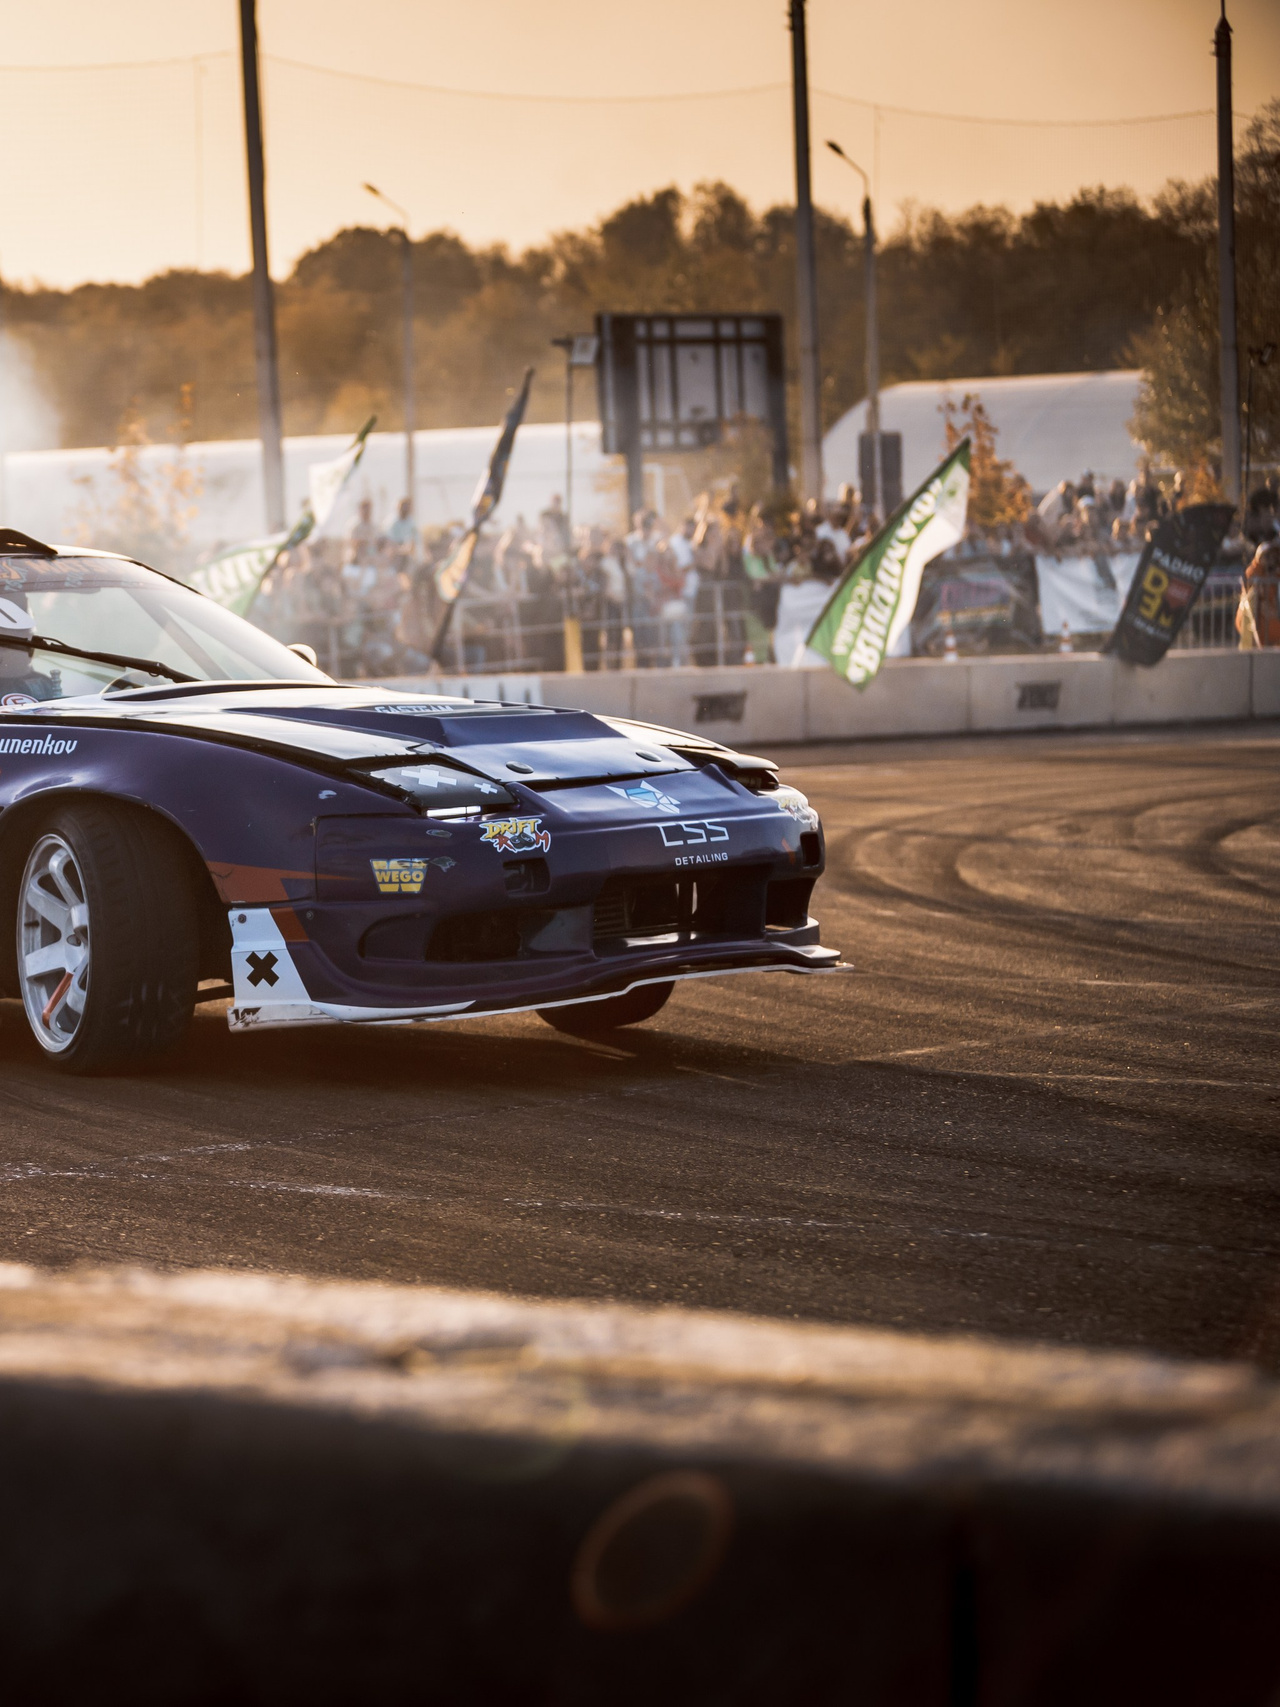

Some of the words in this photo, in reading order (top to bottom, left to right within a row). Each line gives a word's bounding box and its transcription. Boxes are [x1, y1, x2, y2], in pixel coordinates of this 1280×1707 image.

[479, 818, 540, 841] DRIFT
[656, 820, 730, 847] CSS
[675, 852, 729, 866] DETAILING
[375, 870, 424, 882] WEGO
